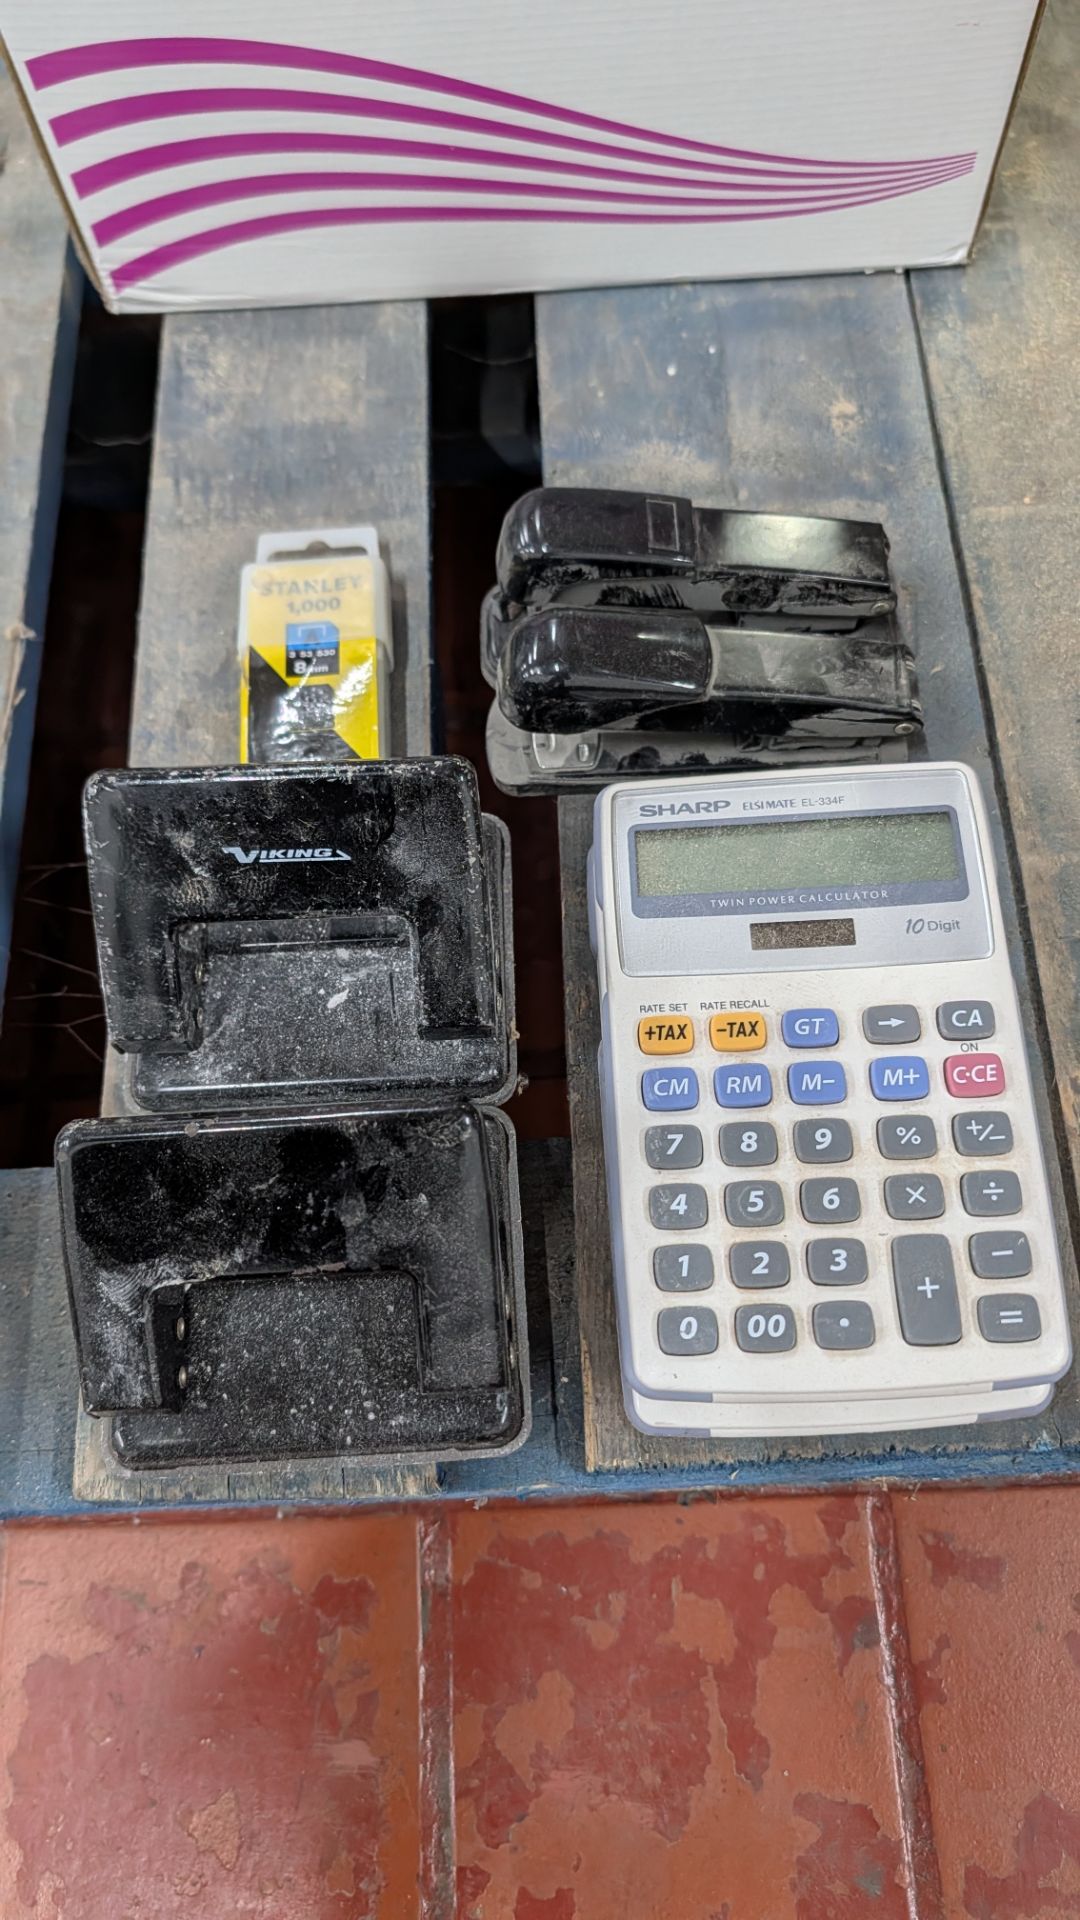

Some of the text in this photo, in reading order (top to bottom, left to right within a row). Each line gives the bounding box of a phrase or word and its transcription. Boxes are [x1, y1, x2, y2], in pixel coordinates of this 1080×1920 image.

[261, 575, 363, 596] STANLEY
[287, 598, 341, 615] 1,000
[639, 796, 844, 817] SHARP ELSIMATE EL-334F
[222, 847, 334, 863] VIKING
[710, 890, 888, 908] TWIN POWER CALCULATOR
[905, 918, 960, 934] 10 Digit
[639, 1003, 688, 1013] RATE SET
[700, 999, 770, 1011] RATE RECALL
[794, 1017, 824, 1035] GT
[951, 1010, 983, 1027] CA
[645, 1023, 687, 1041] +TAX
[716, 1020, 758, 1038] -TAX
[960, 1042, 978, 1053] ON
[654, 1077, 689, 1096] CM
[726, 1075, 762, 1094] RM
[802, 1073, 835, 1091] M-
[883, 1069, 920, 1086] M+
[666, 1134, 683, 1154] 7
[740, 1131, 758, 1152] 8
[815, 1128, 832, 1150] 9
[896, 1126, 921, 1144] %
[670, 1193, 688, 1215] 4
[747, 1190, 764, 1212] 5
[822, 1187, 840, 1209] 6
[677, 1255, 689, 1276] 1
[752, 1252, 769, 1274] 2
[829, 1249, 848, 1271] 3
[679, 1317, 697, 1340] 0
[748, 1315, 786, 1338] 00
